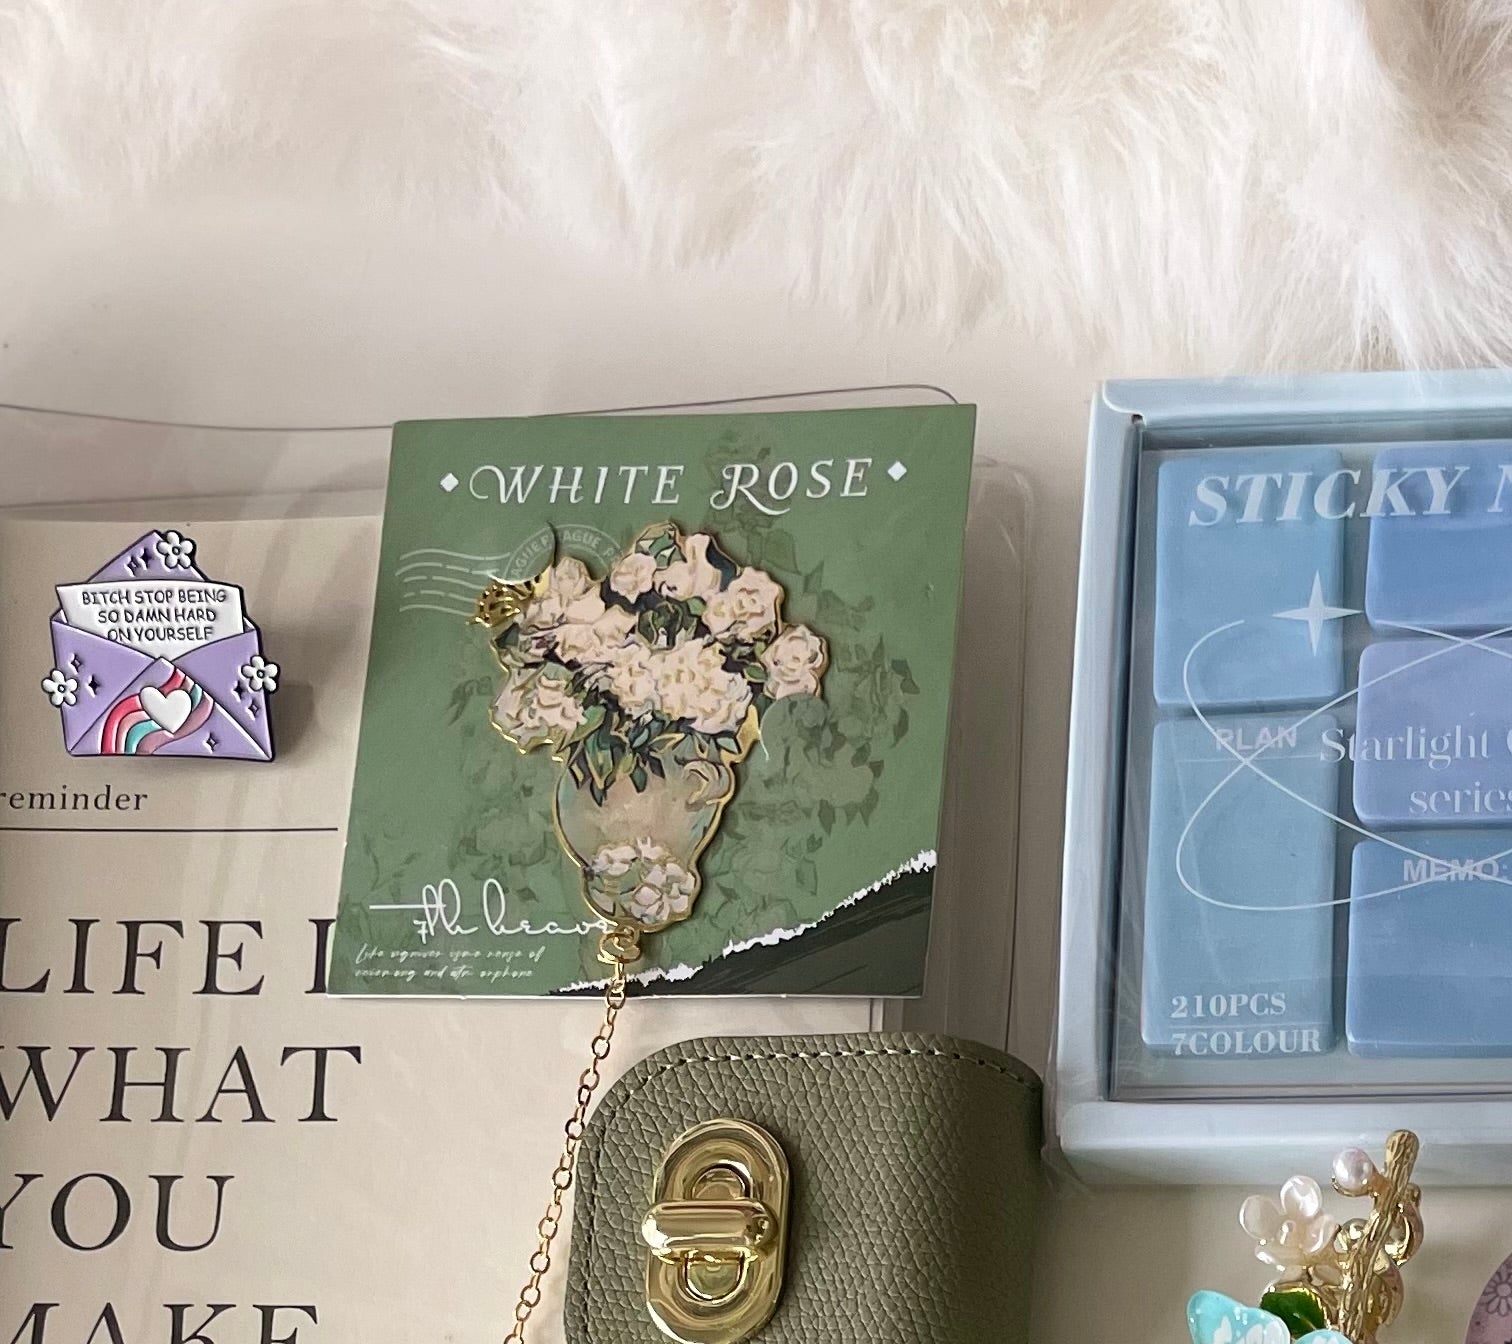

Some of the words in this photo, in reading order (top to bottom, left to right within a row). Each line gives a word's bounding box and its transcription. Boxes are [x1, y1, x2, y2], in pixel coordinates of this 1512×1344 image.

[468, 463, 685, 504] WHITE
[709, 457, 874, 515] ROSE
[1187, 466, 1470, 529] STICKY
[81, 589, 130, 605] BITCH
[134, 589, 173, 605] STOP
[178, 588, 228, 604] BEING
[98, 609, 120, 624] SO
[124, 609, 171, 624] DAMN
[174, 608, 217, 623] HARD
[107, 627, 131, 642] ON
[134, 626, 215, 641] YOURSELF
[1215, 726, 1298, 751] PLAN
[1319, 722, 1490, 771] Starlight
[1403, 858, 1509, 883] MEMO:
[0, 917, 266, 996] LIFE
[304, 917, 336, 995] I
[1170, 992, 1287, 1019] 210PCS
[1171, 1028, 1322, 1056] 7COLOUR
[0, 1045, 362, 1123] WHAT
